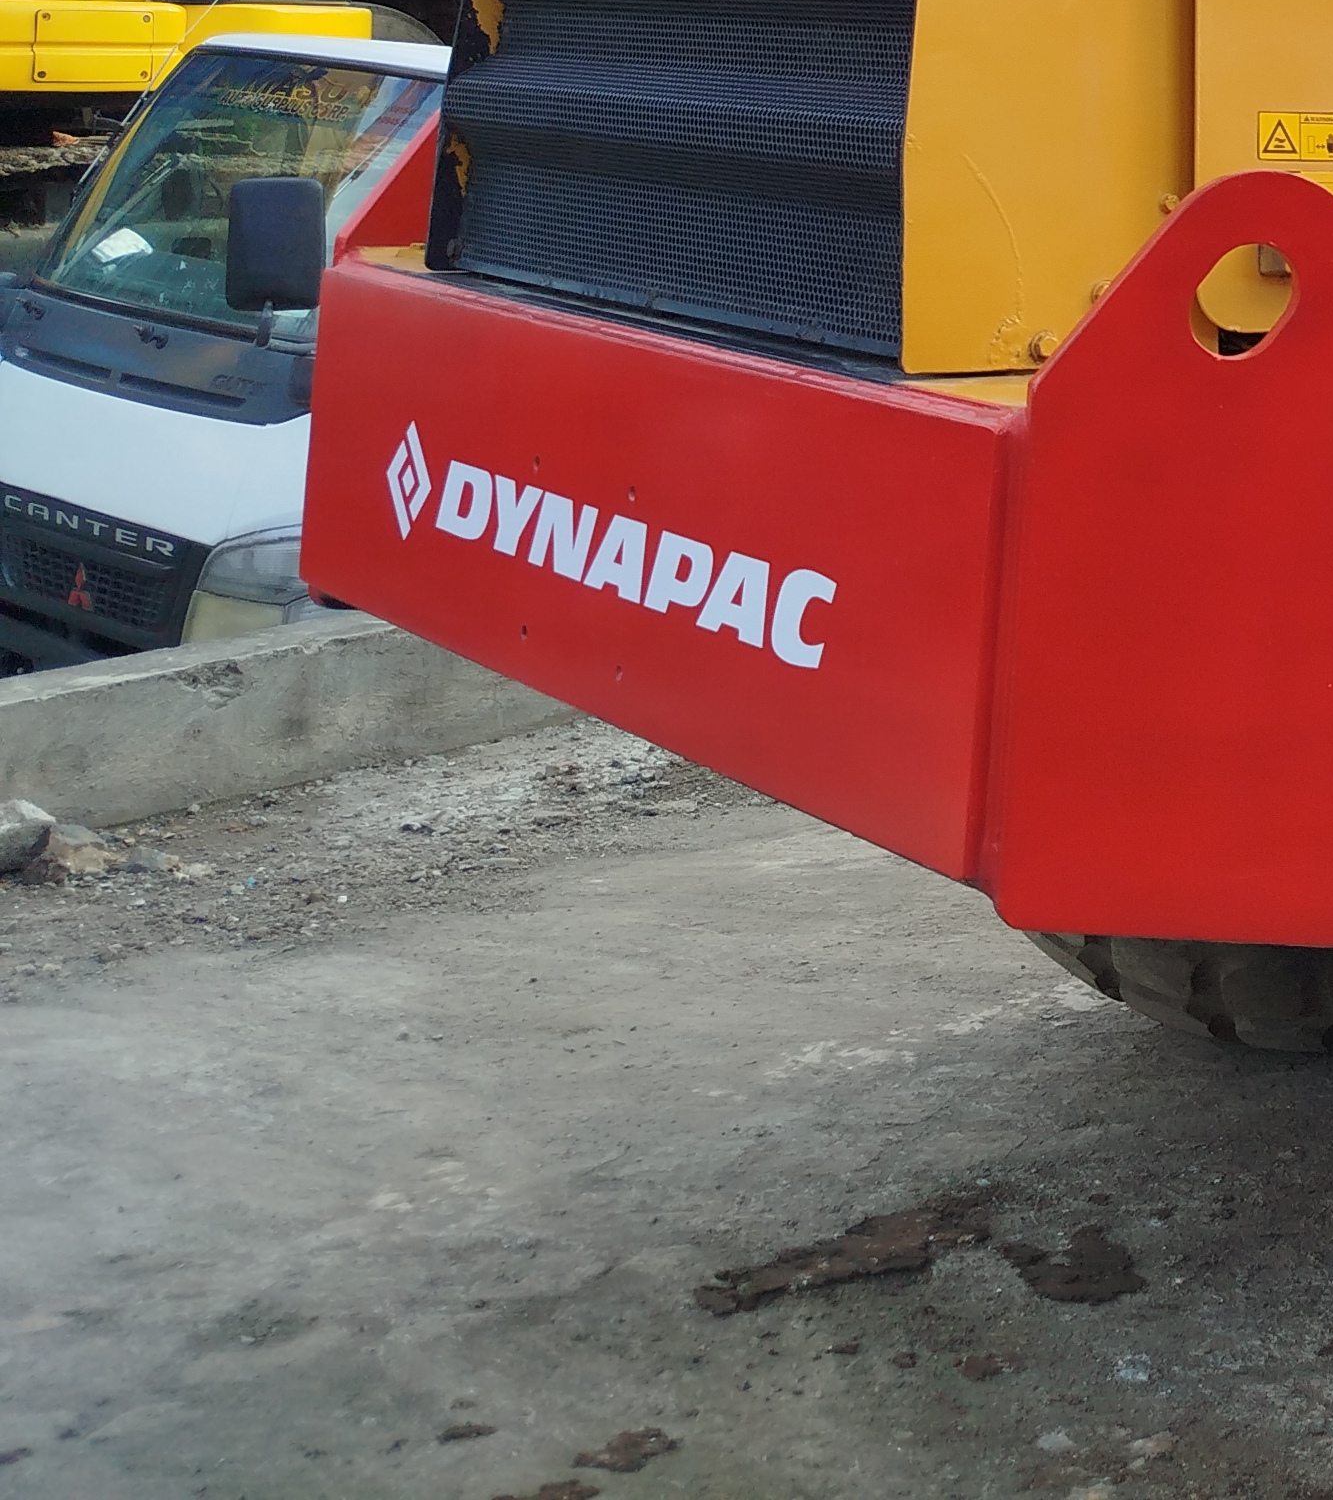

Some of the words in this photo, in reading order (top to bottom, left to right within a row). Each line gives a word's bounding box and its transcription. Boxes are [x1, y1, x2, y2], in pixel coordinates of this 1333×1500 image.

[251, 93, 310, 117] SURPLUS
[4, 494, 176, 557] CANTER
[434, 459, 838, 669] DYNAPAC
